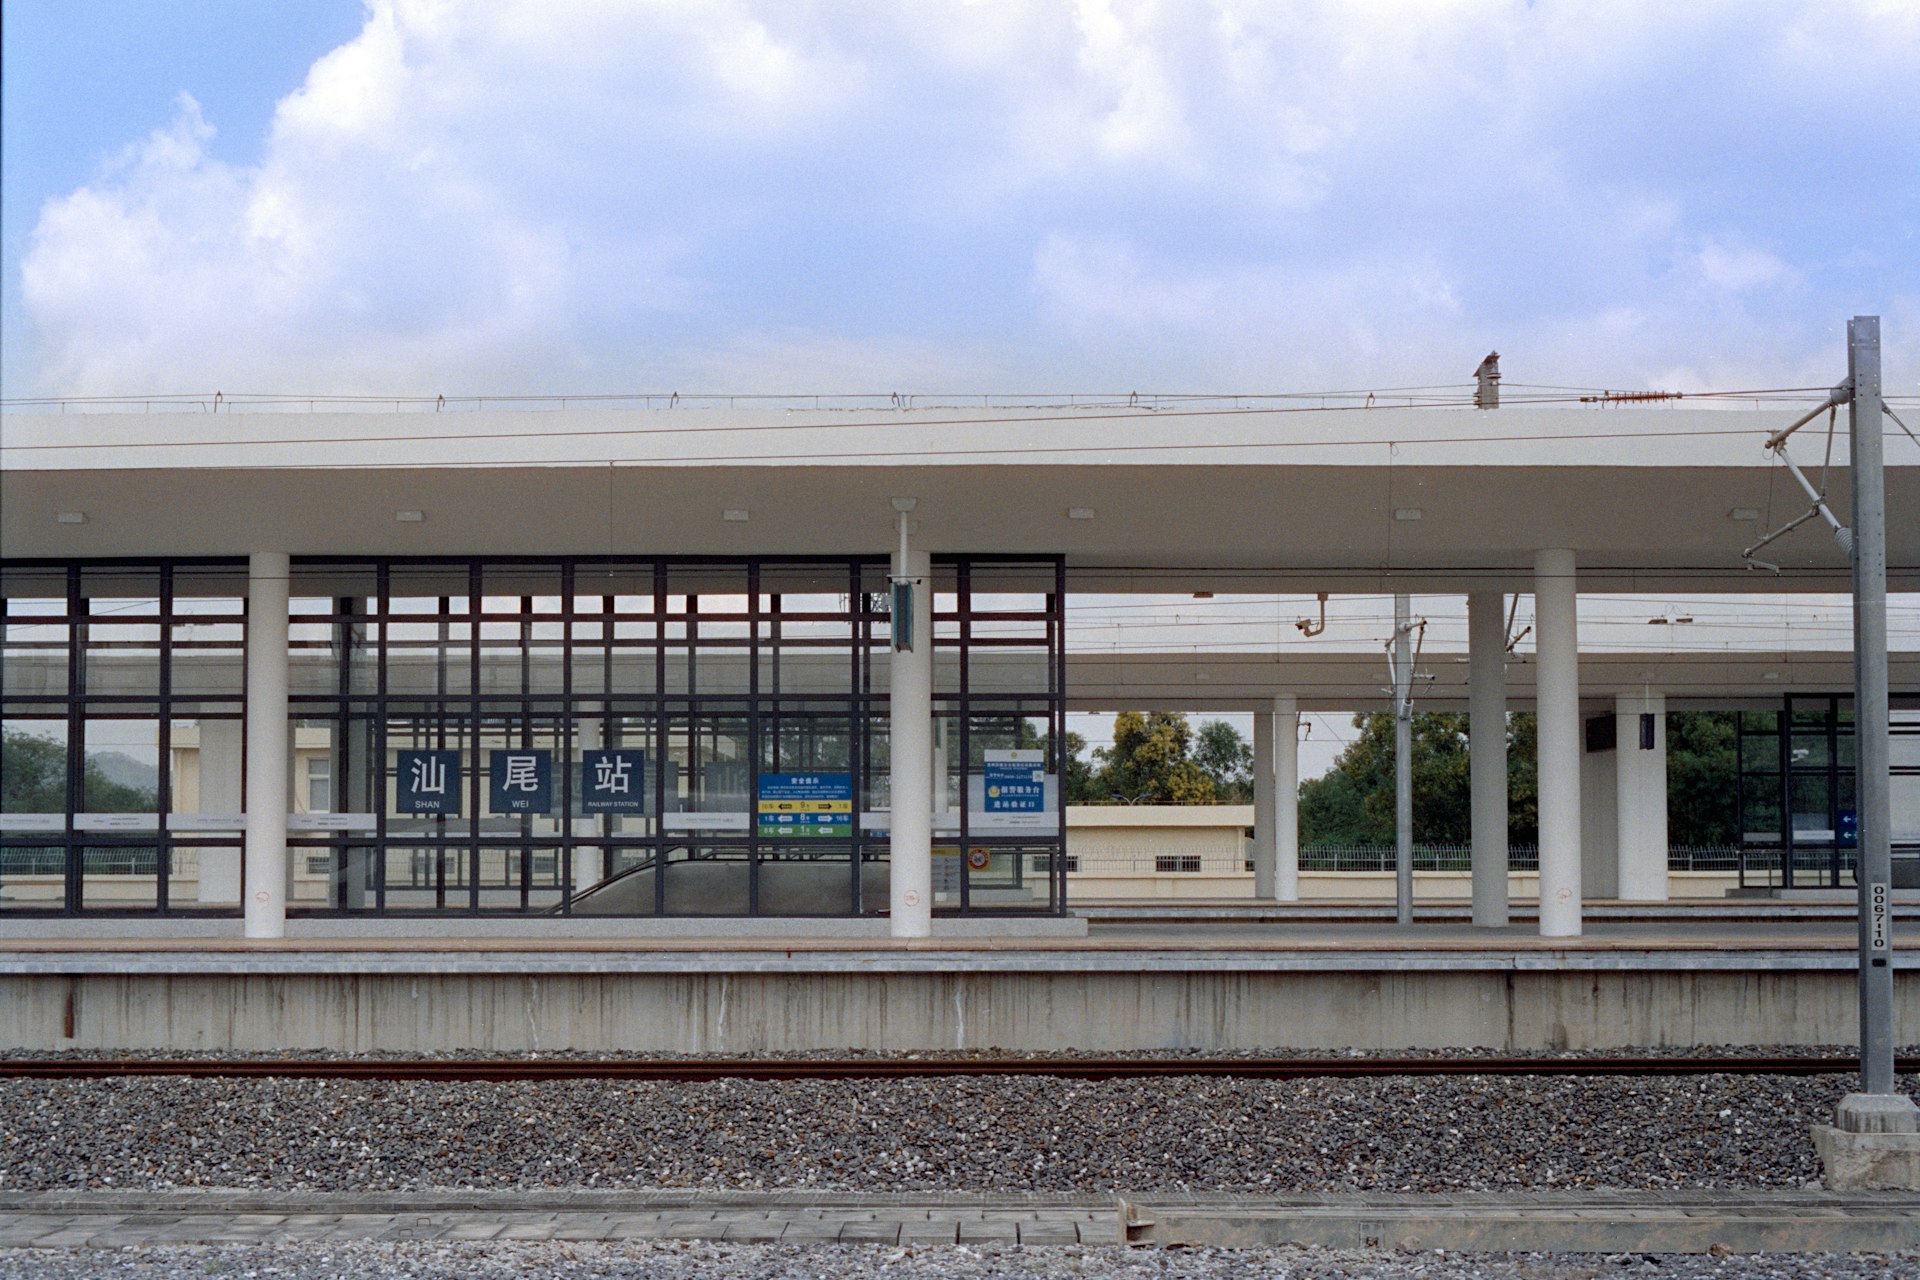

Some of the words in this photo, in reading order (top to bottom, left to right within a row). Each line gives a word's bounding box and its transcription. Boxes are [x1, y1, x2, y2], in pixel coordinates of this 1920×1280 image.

[411, 756, 445, 794] 汕
[502, 756, 538, 792] 尾
[595, 755, 632, 794] 站
[512, 800, 529, 808] WEI
